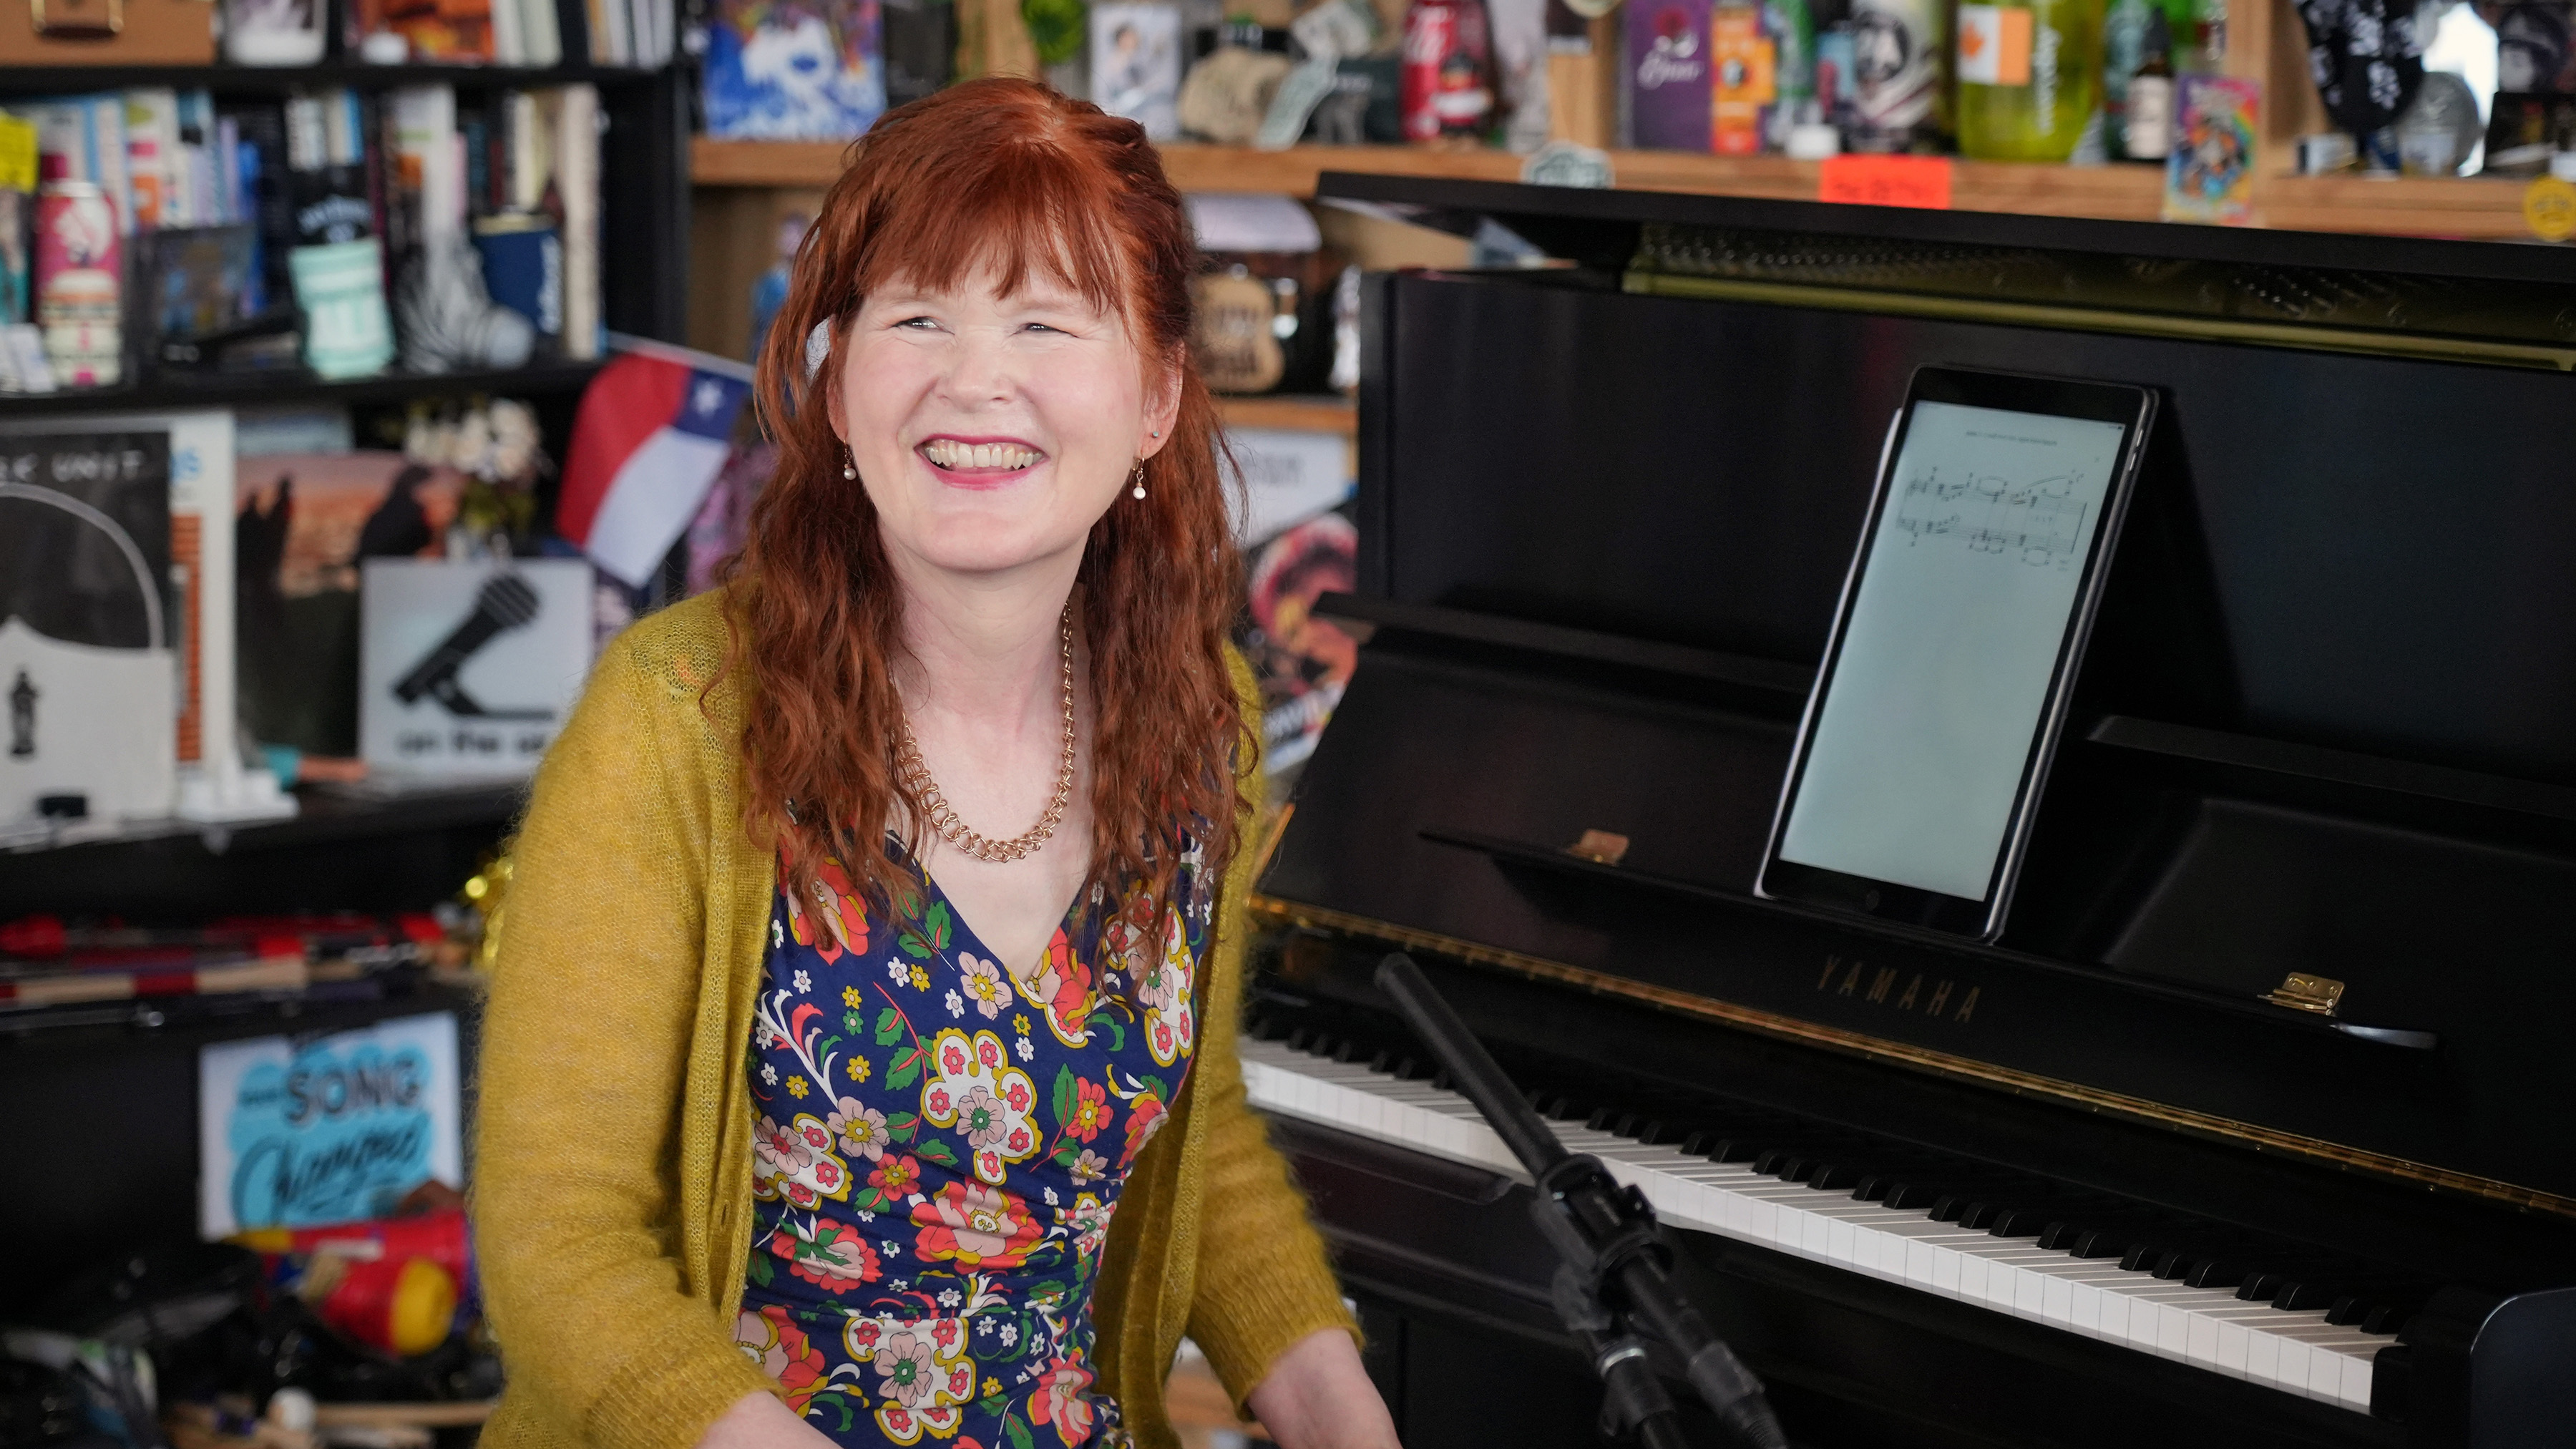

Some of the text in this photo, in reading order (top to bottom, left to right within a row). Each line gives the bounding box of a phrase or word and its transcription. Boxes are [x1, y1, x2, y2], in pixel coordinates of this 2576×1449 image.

[50, 451, 144, 482] UNIT
[452, 730, 500, 754] the
[1818, 955, 1981, 1023] YAMAHA
[285, 1057, 422, 1126] SONG
